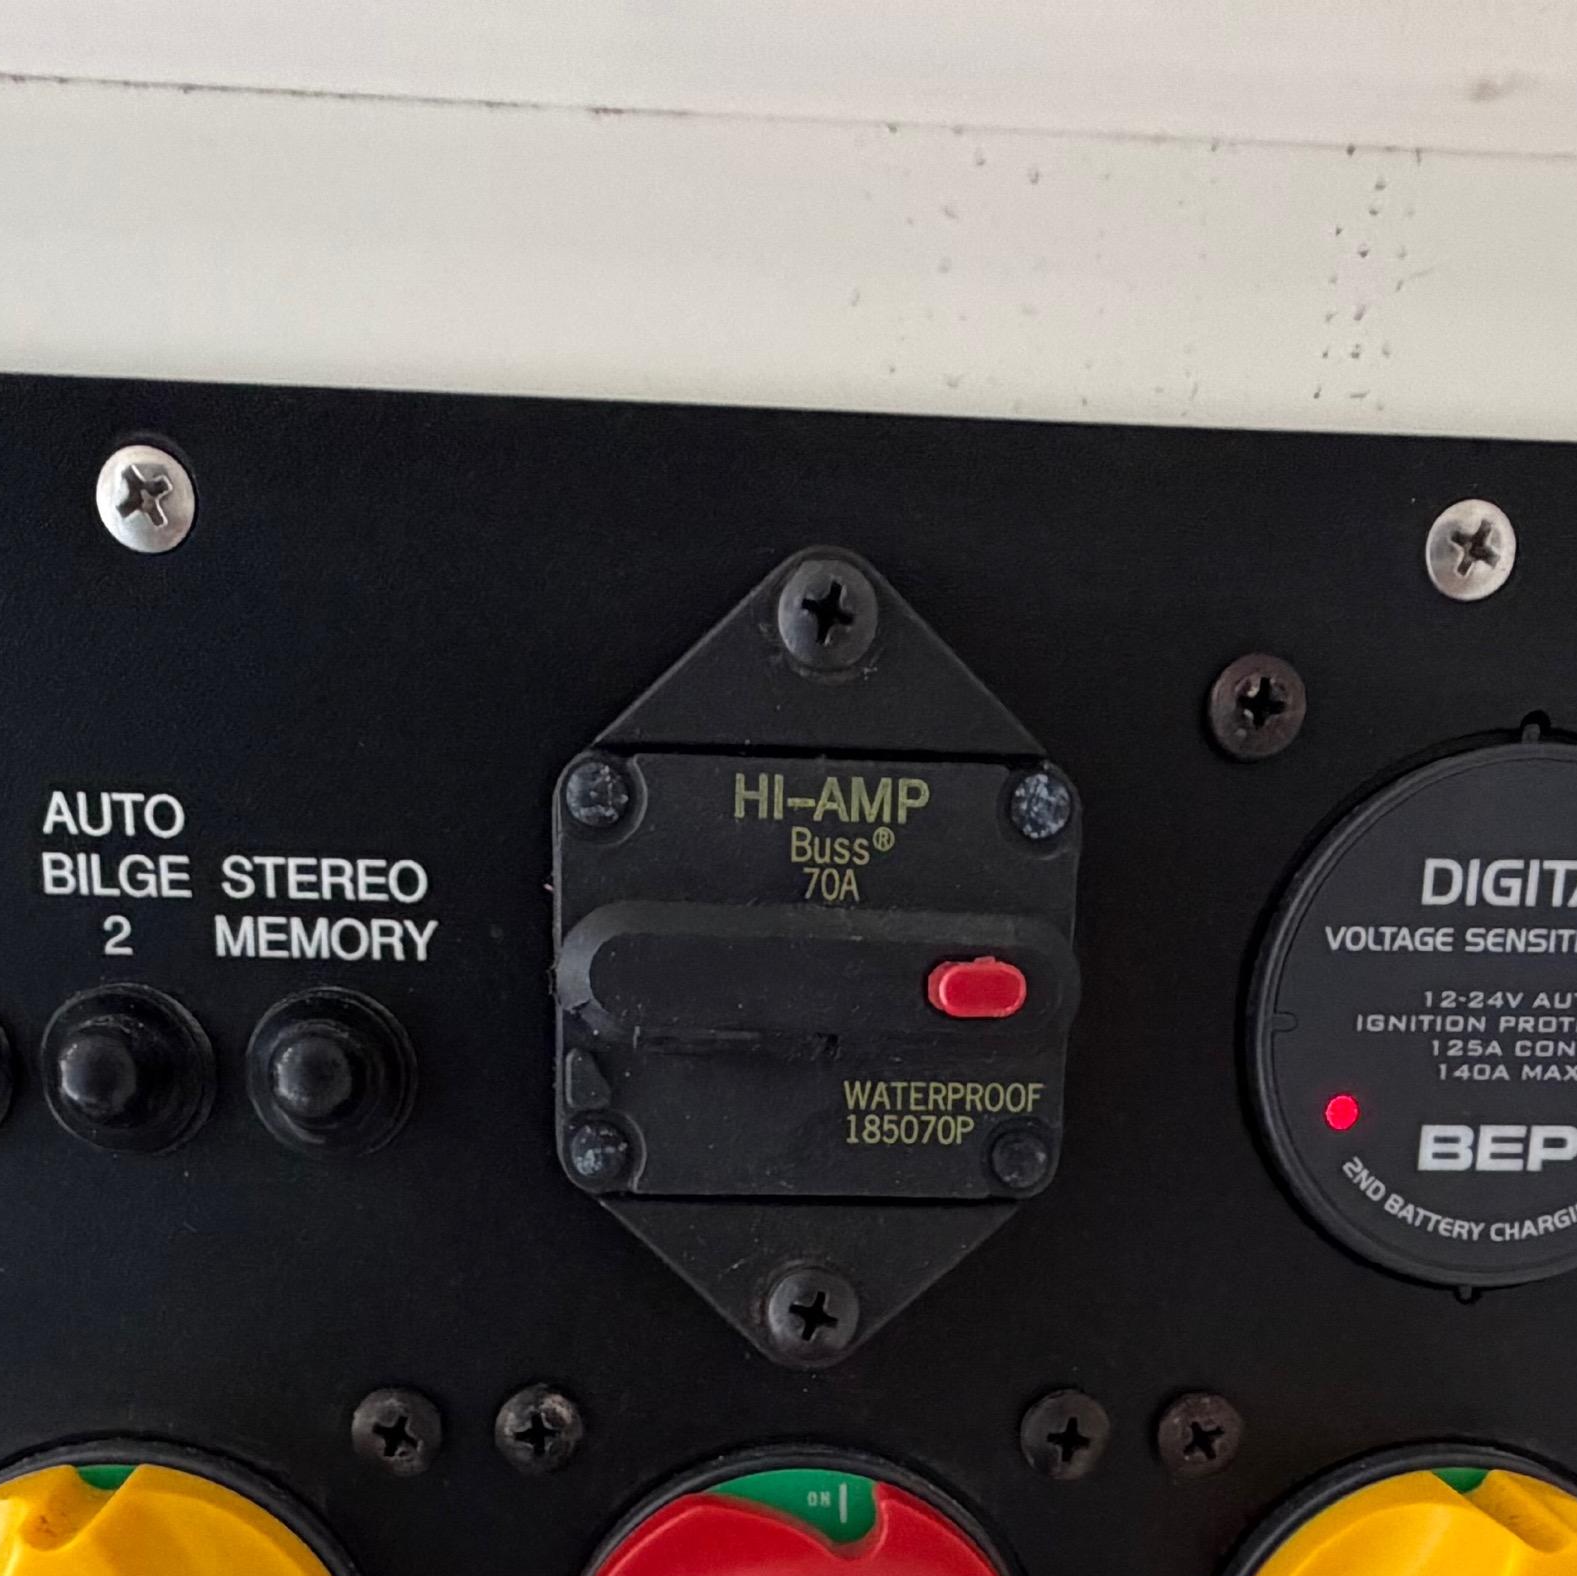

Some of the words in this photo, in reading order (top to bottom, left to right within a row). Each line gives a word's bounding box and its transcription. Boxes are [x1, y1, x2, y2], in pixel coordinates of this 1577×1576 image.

[42, 791, 185, 839] AUTO
[734, 772, 930, 825] HI-AMP
[42, 852, 192, 898] BILGE
[221, 856, 428, 903] STEREO
[803, 866, 861, 903] 70A
[103, 915, 134, 956] 2
[214, 915, 438, 962] MEMORY
[1325, 926, 1454, 953] VOLTAGE
[1424, 990, 1524, 1010] 12-24V
[1356, 1014, 1487, 1034] IGNITION
[1432, 1039, 1503, 1058] 125A
[1438, 1063, 1511, 1082] 140A
[843, 1080, 1047, 1113] WATERPROOF
[845, 1114, 975, 1145] 185070P
[1341, 1156, 1386, 1202] 2ND
[1384, 1192, 1485, 1242] BATTERY
